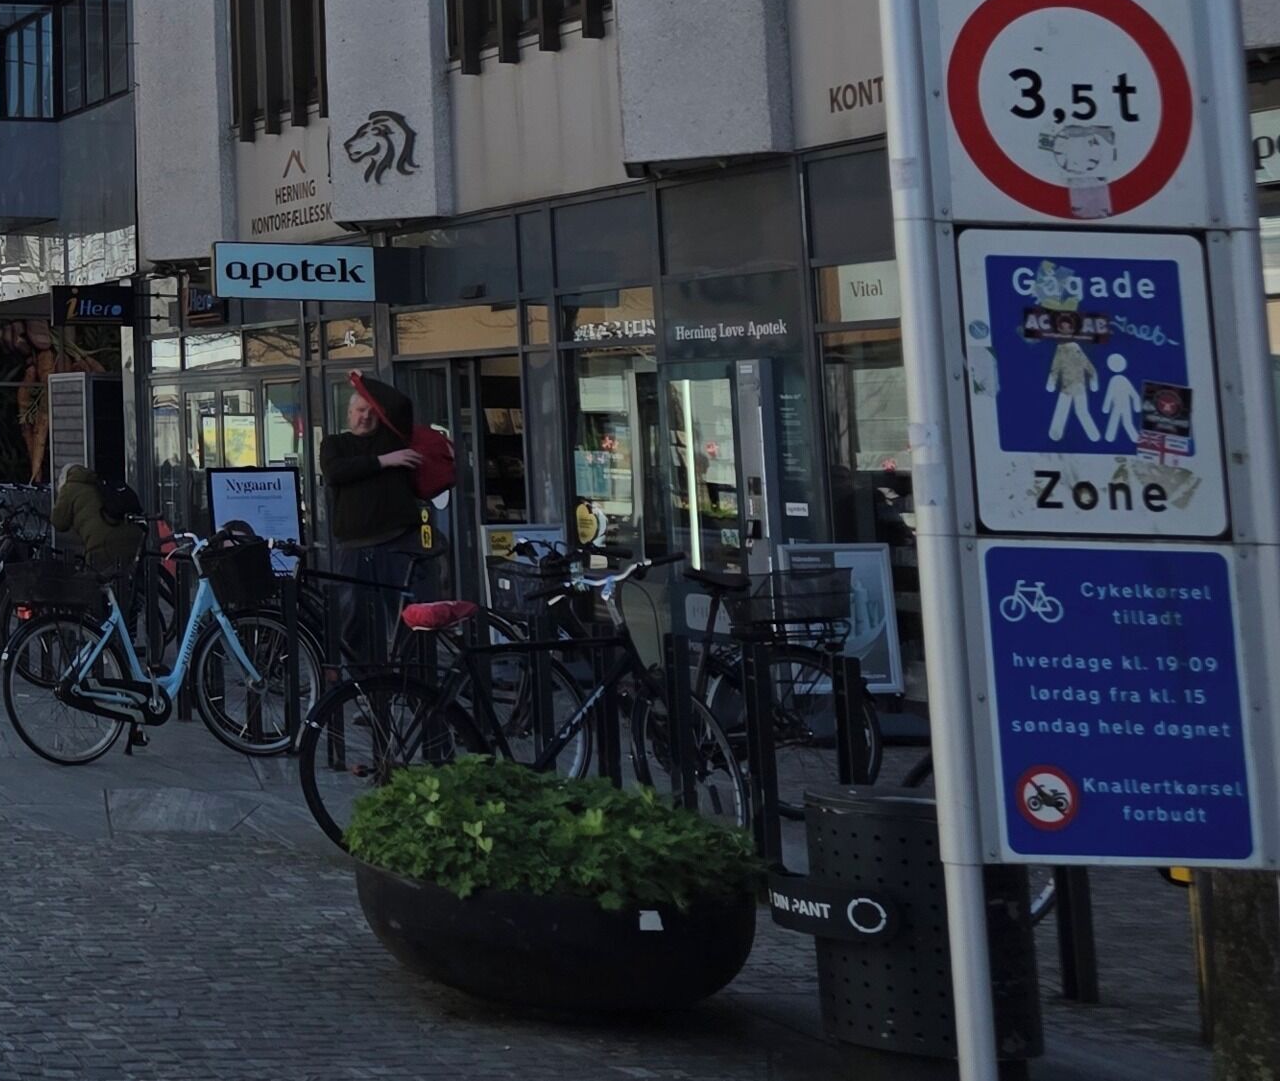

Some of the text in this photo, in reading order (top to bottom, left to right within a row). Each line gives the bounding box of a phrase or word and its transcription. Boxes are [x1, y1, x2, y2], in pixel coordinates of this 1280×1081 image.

[1008, 68, 1139, 123] 3,5 t
[275, 179, 316, 206] HERNING
[225, 258, 366, 289] apotek
[850, 279, 883, 298] Vital
[675, 325, 717, 342] Herning
[748, 318, 787, 340] Apotek
[225, 477, 282, 494] Nygaard
[1036, 471, 1168, 512] Zone
[1080, 582, 1212, 601] Cykelkørsel
[1112, 609, 1183, 626] tilladt
[1012, 652, 1113, 672] hverdage
[1122, 655, 1149, 670] kl.
[1030, 685, 1207, 704] lørdag fra kl. 15
[1011, 719, 1231, 739] søndag hele døgnet
[1082, 777, 1243, 797] Knallertkørsel
[1122, 805, 1207, 822] forbudt
[773, 891, 790, 911] DIN
[791, 898, 831, 919] PANT
